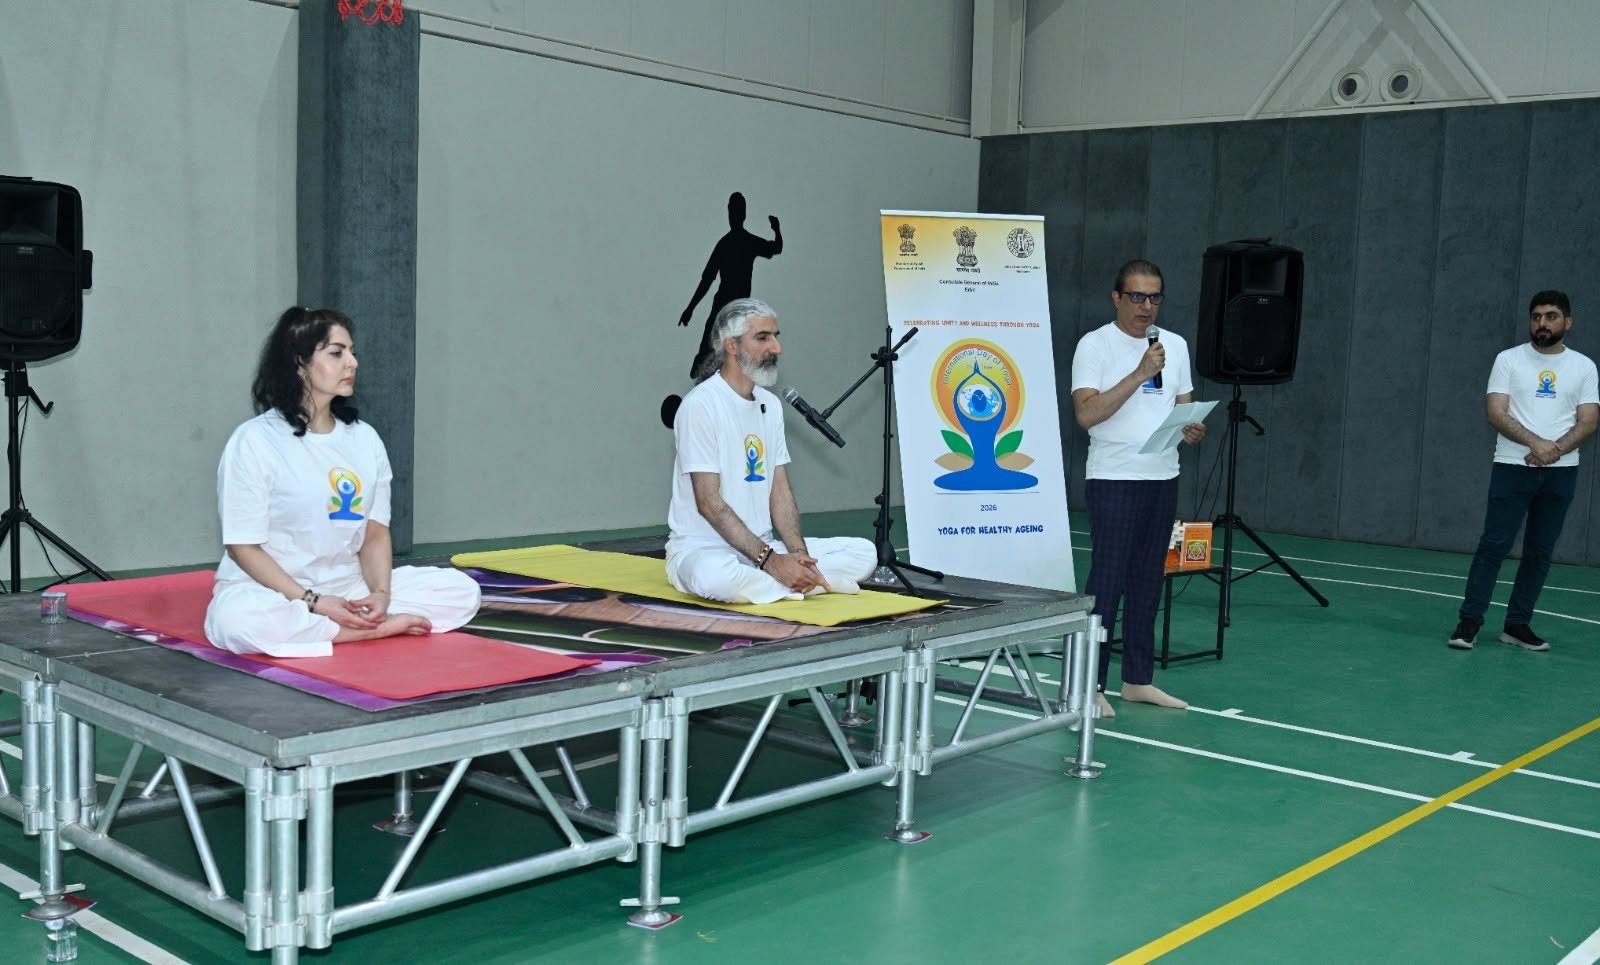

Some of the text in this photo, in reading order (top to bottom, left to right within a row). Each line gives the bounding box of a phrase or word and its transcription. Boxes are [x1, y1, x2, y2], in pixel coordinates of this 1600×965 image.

[943, 349, 975, 385] International
[977, 348, 993, 360] Day
[992, 357, 1002, 366] of
[980, 504, 998, 512] 2026
[938, 524, 1044, 535] YOGA FOR HEALTHY AGEING
